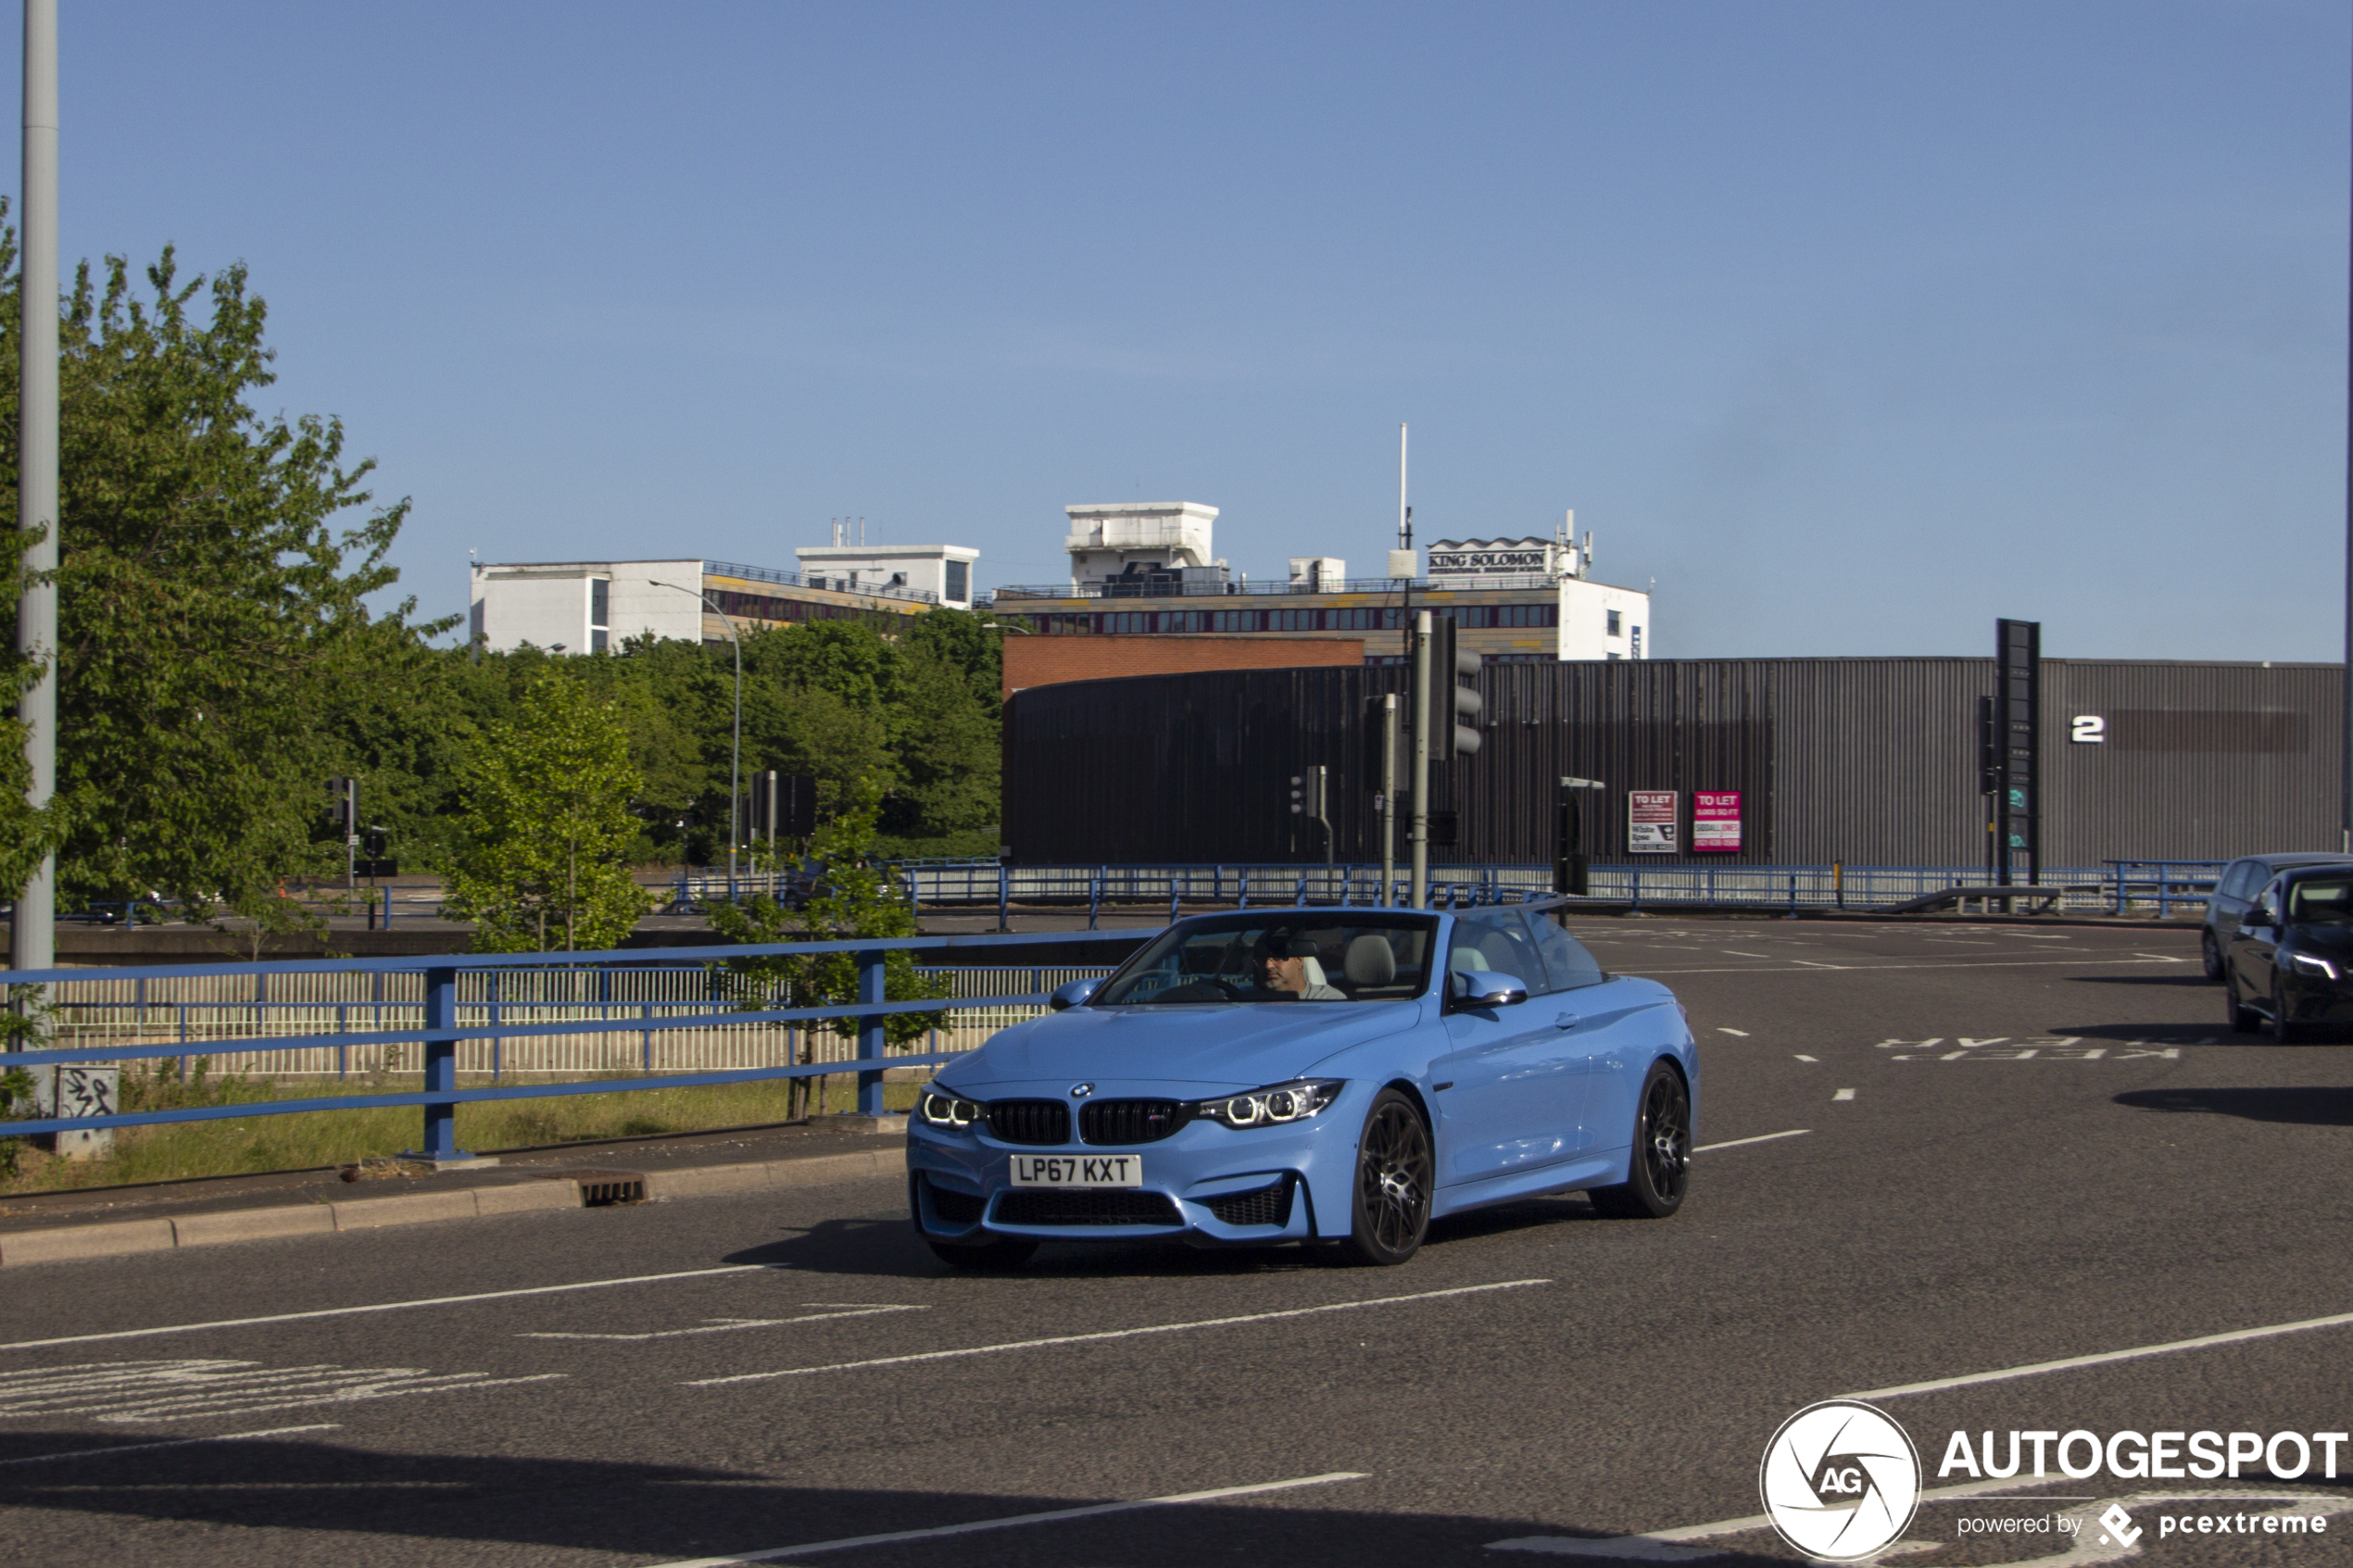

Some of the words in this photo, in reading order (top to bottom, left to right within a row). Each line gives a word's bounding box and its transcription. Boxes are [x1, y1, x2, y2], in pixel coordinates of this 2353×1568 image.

[1428, 555, 1466, 567] KING
[1470, 554, 1544, 566] SOLOMON
[2072, 715, 2104, 742] 2
[1635, 796, 1649, 804] TO
[1651, 796, 1671, 804] LET
[1698, 796, 1715, 806] TO
[1716, 796, 1738, 806] LET
[1892, 1048, 2180, 1060] KEEP
[1019, 1158, 1076, 1182] LP67
[1083, 1158, 1129, 1182] KXT
